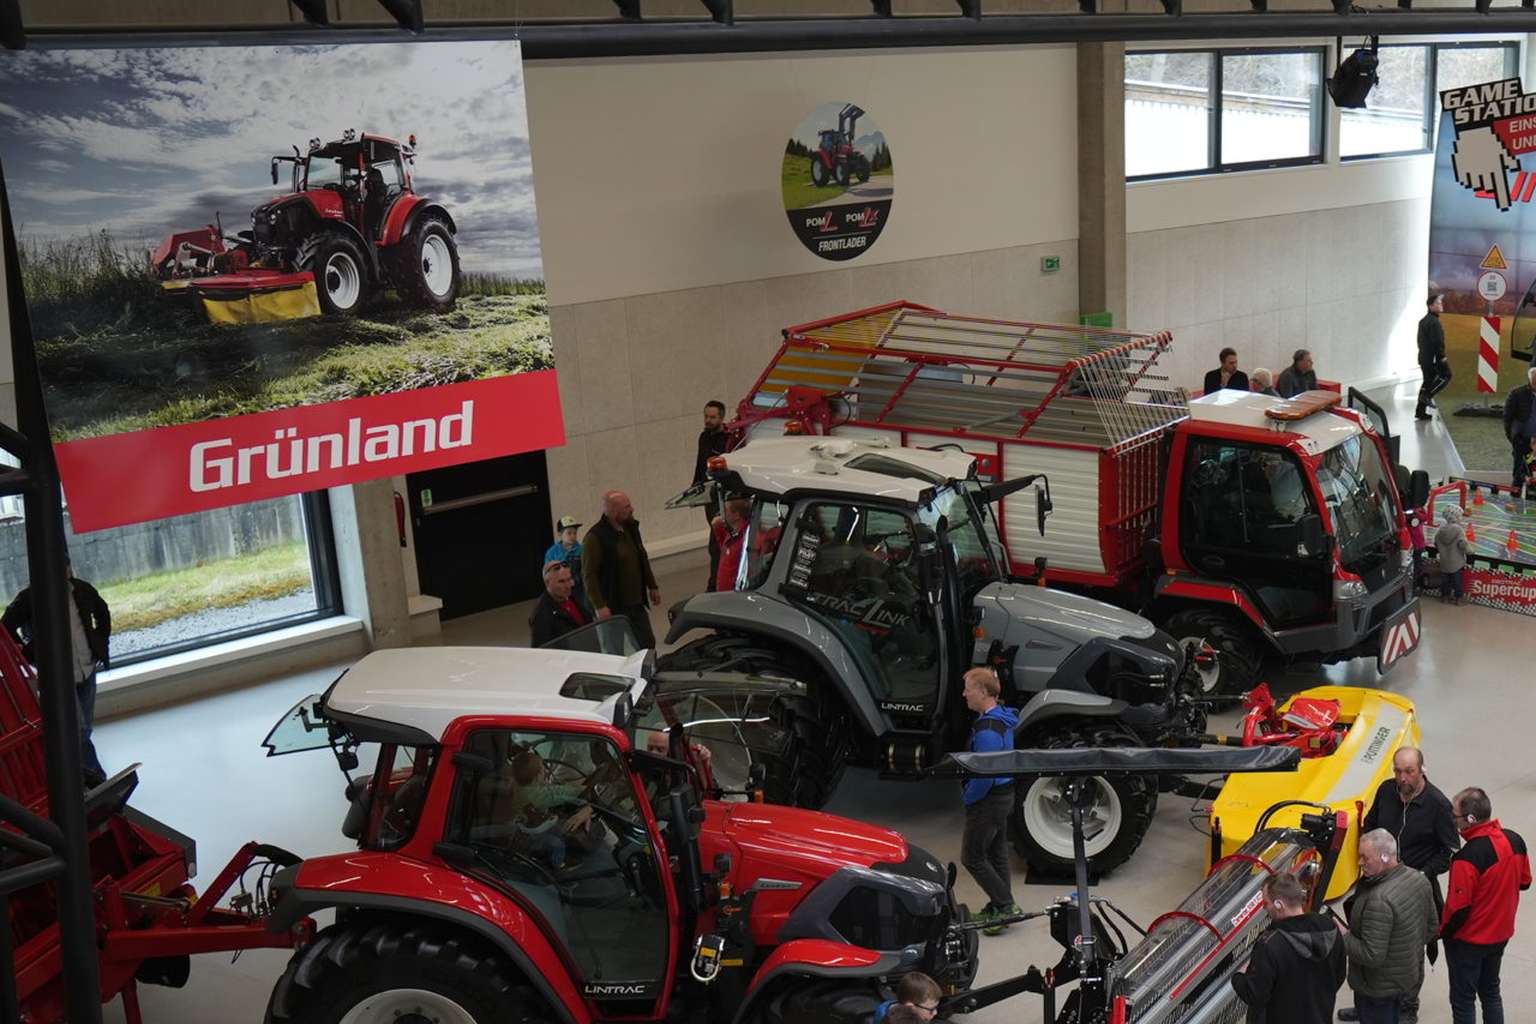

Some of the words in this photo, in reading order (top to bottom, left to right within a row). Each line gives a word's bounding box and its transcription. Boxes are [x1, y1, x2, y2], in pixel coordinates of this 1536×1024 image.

[1443, 79, 1519, 111] GAME
[818, 237, 867, 252] FRONTLADER
[189, 399, 475, 494] Grünland
[584, 985, 646, 995] LINTRAC
